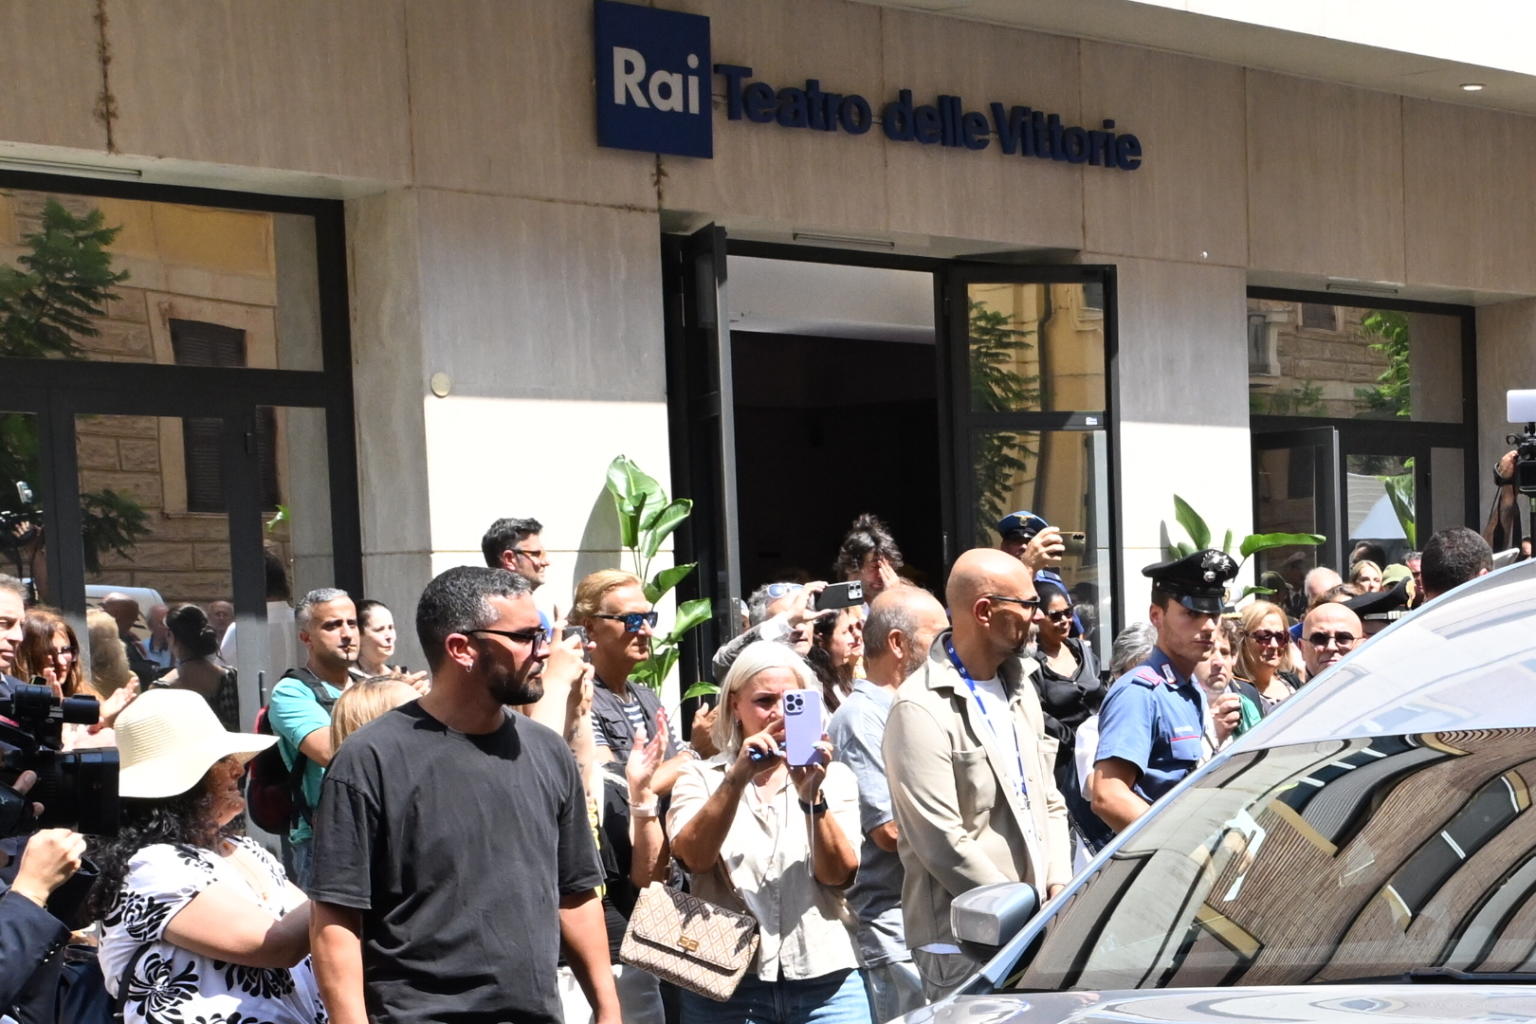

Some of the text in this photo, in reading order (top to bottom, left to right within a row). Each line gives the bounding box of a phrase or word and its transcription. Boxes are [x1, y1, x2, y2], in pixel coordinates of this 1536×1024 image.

[612, 46, 700, 115] Rai
[713, 63, 1143, 171] Teatro delle Vittorie
